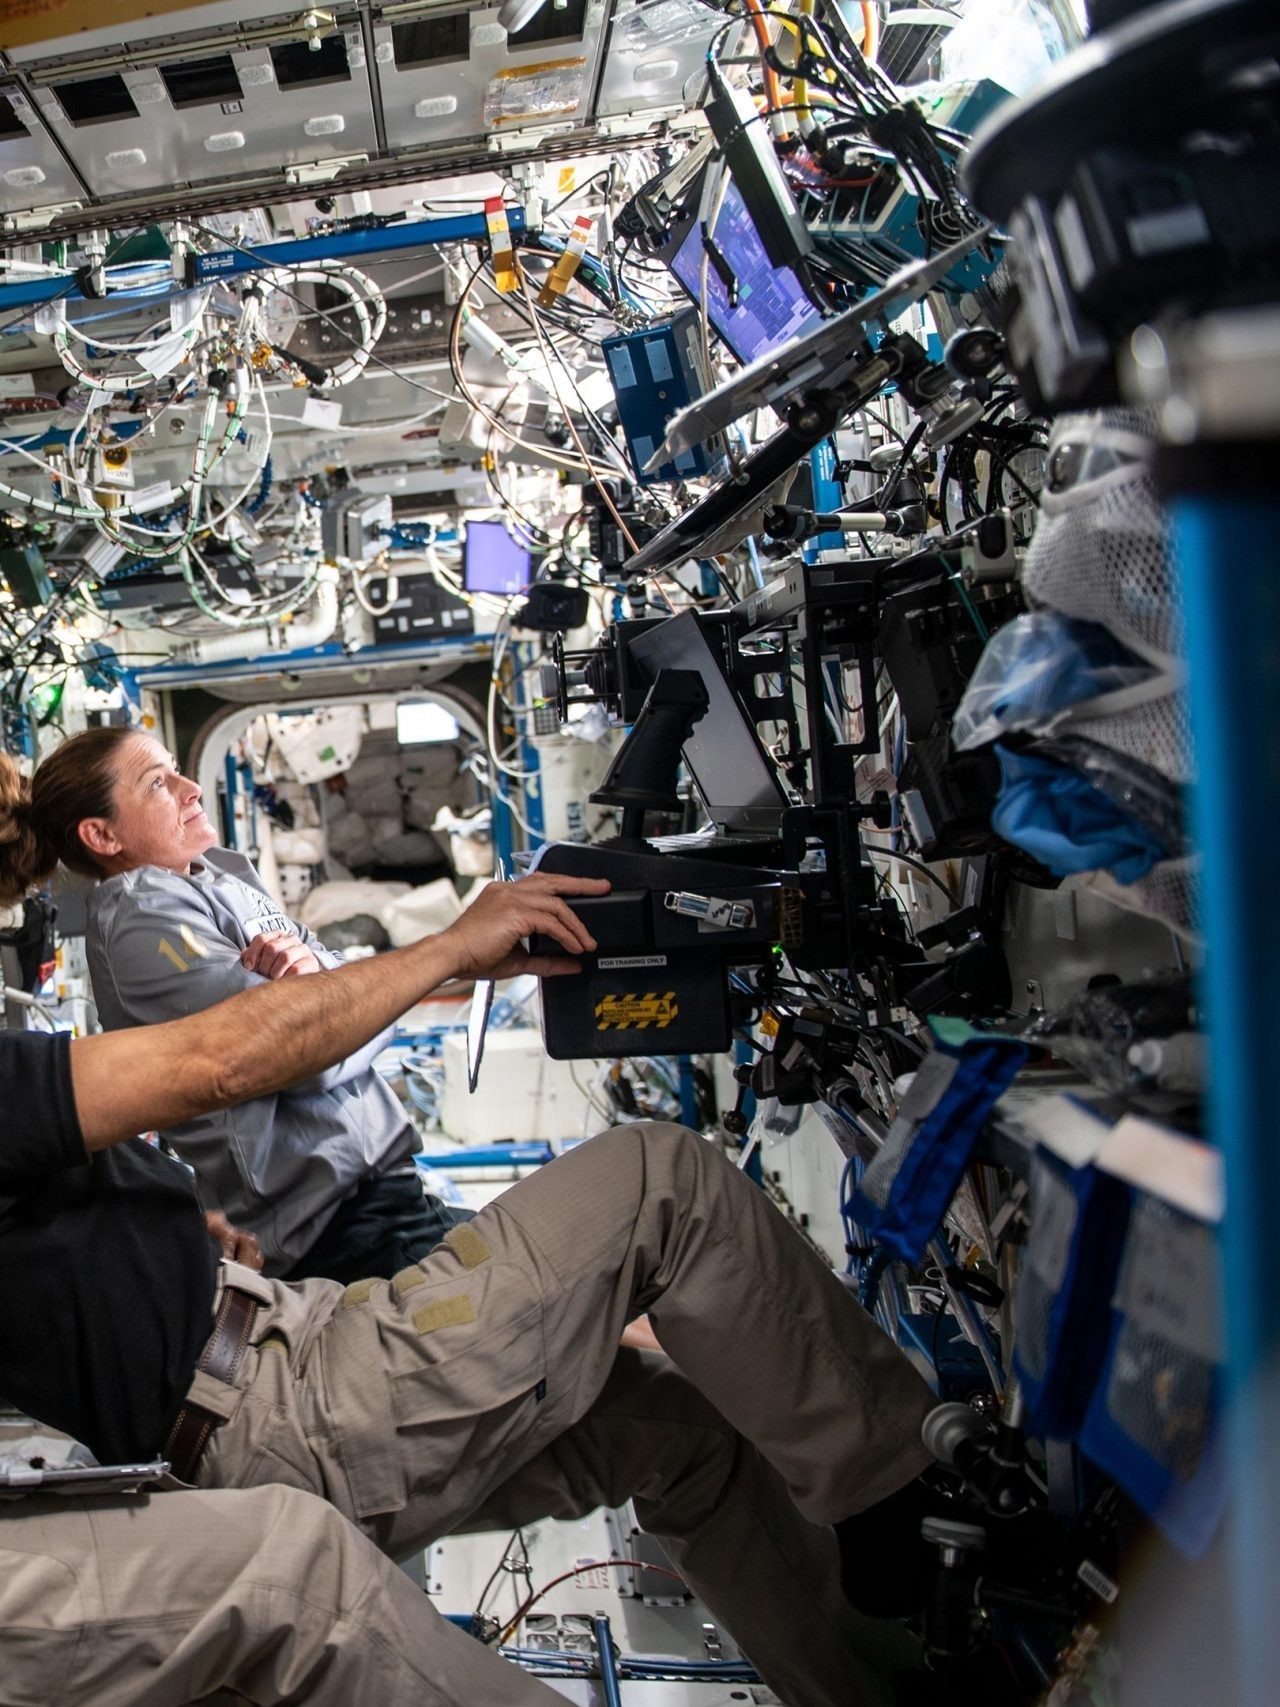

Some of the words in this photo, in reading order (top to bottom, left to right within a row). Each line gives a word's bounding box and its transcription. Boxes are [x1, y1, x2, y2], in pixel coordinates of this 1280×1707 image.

[600, 960, 614, 968] FOR
[615, 958, 646, 967] TRAINING
[647, 957, 664, 965] ONLY
